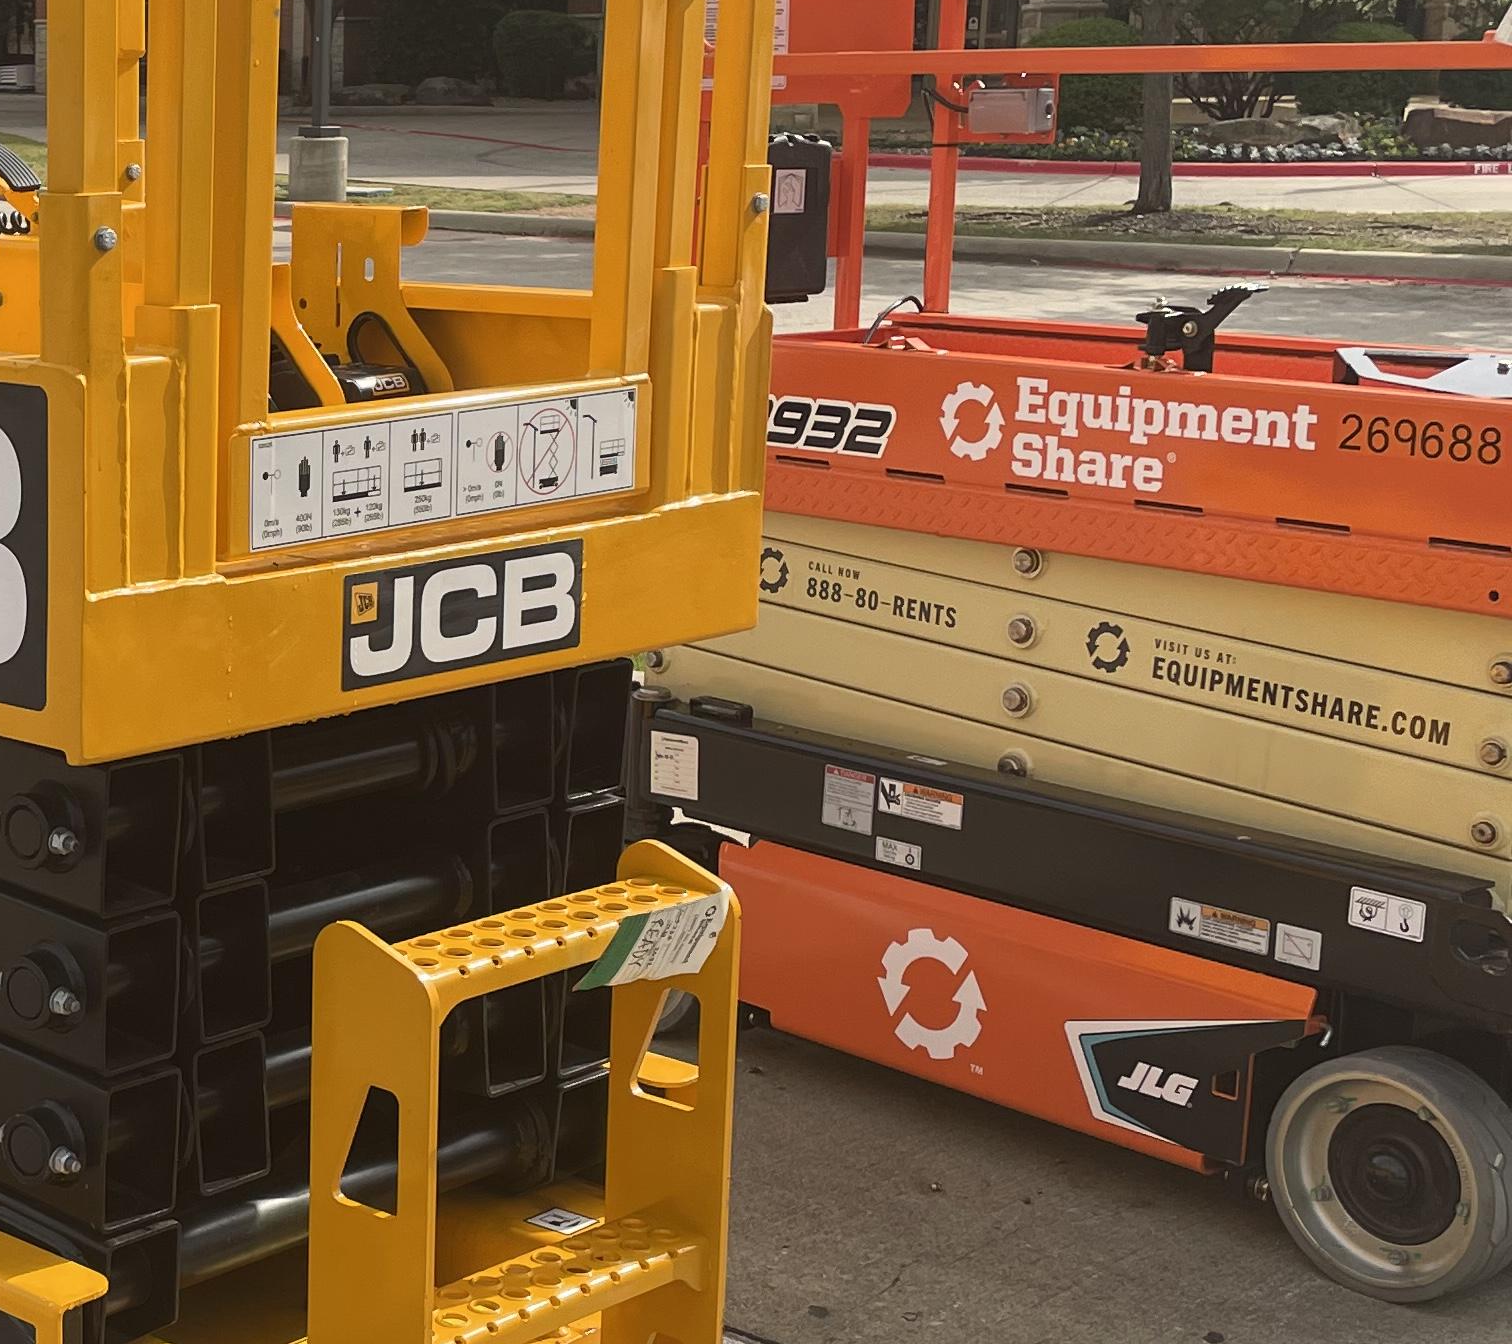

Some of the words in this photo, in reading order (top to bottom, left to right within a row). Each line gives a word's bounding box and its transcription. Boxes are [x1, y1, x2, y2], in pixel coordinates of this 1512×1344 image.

[374, 375, 406, 392] JCB
[767, 396, 896, 457] 932
[1014, 376, 1318, 452] Equipment
[1338, 412, 1502, 465] 269688
[808, 561, 833, 575] CALL
[838, 566, 861, 580] NOW
[350, 552, 575, 678] JCB
[806, 577, 957, 629] 888-80-RENTS
[1154, 638, 1189, 656] VISIT
[1194, 646, 1210, 660] US
[1216, 651, 1237, 665] AT:
[1152, 656, 1451, 746] EQUIPMENTSHARE.COM
[1117, 1061, 1199, 1107] JLG
